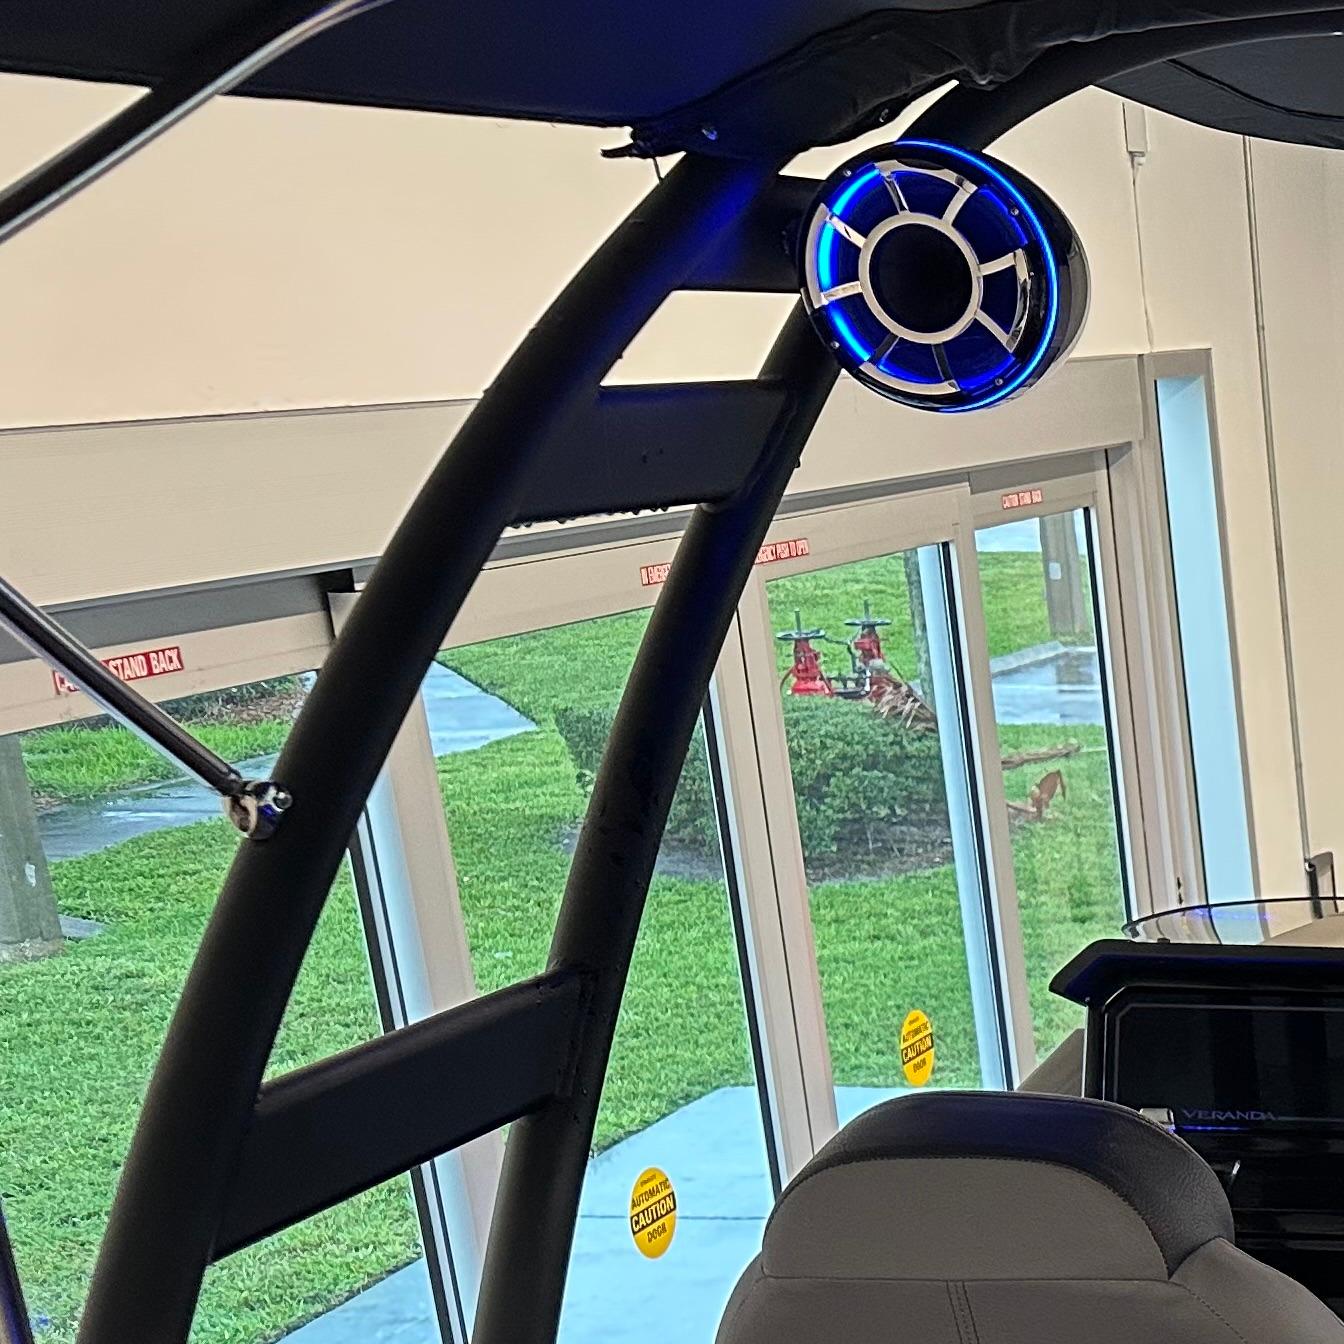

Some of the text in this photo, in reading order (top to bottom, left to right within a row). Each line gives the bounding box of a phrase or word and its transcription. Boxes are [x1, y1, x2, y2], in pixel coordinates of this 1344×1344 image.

[108, 648, 183, 681] STAND BACK
[902, 1034, 933, 1063] CAUTION
[1182, 1109, 1277, 1121] VERANDA
[631, 1177, 671, 1211] AUTOMATIC
[631, 1193, 675, 1233] CAUTION
